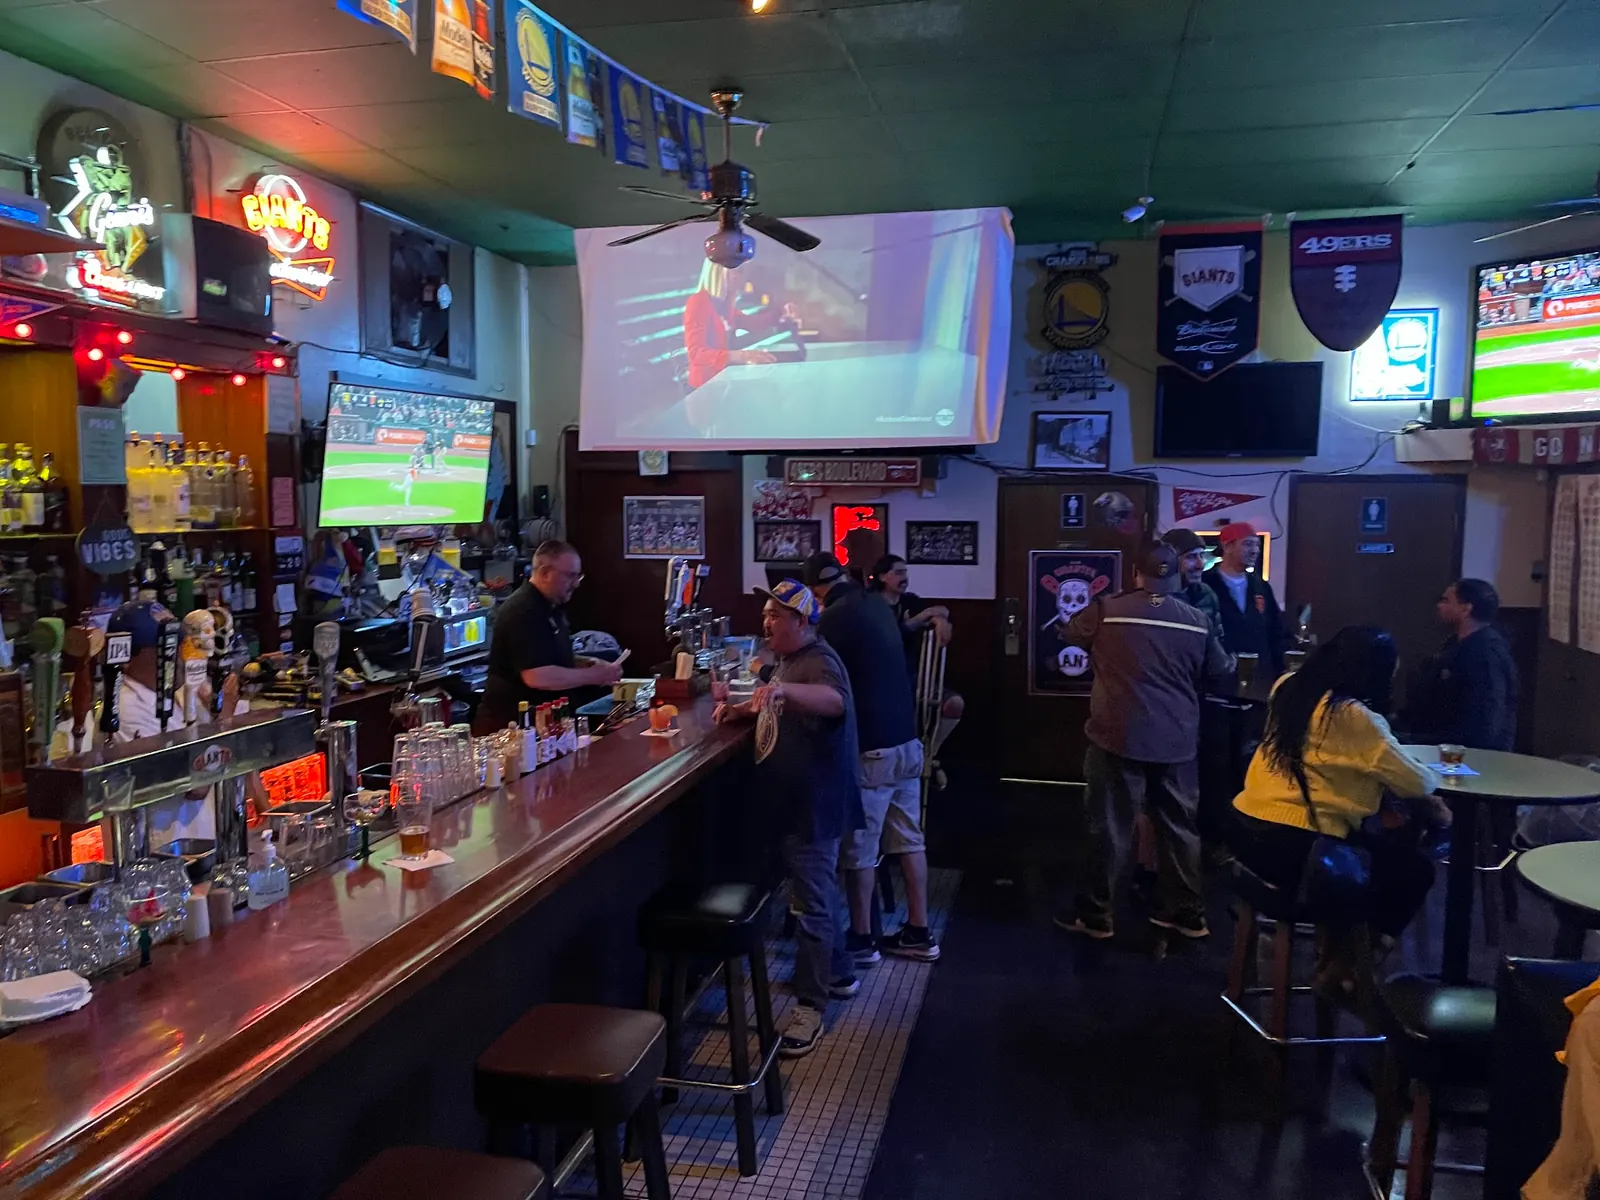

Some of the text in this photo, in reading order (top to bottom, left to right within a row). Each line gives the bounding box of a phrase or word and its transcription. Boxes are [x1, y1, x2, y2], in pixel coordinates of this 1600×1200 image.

[241, 194, 331, 250] GIANTS
[1299, 233, 1392, 254] 49ERS
[1181, 269, 1236, 287] GIANTS
[1535, 436, 1563, 457] GO
[826, 461, 886, 480] BOULEVARD
[81, 540, 136, 563] VIBES
[110, 642, 129, 659] IPA
